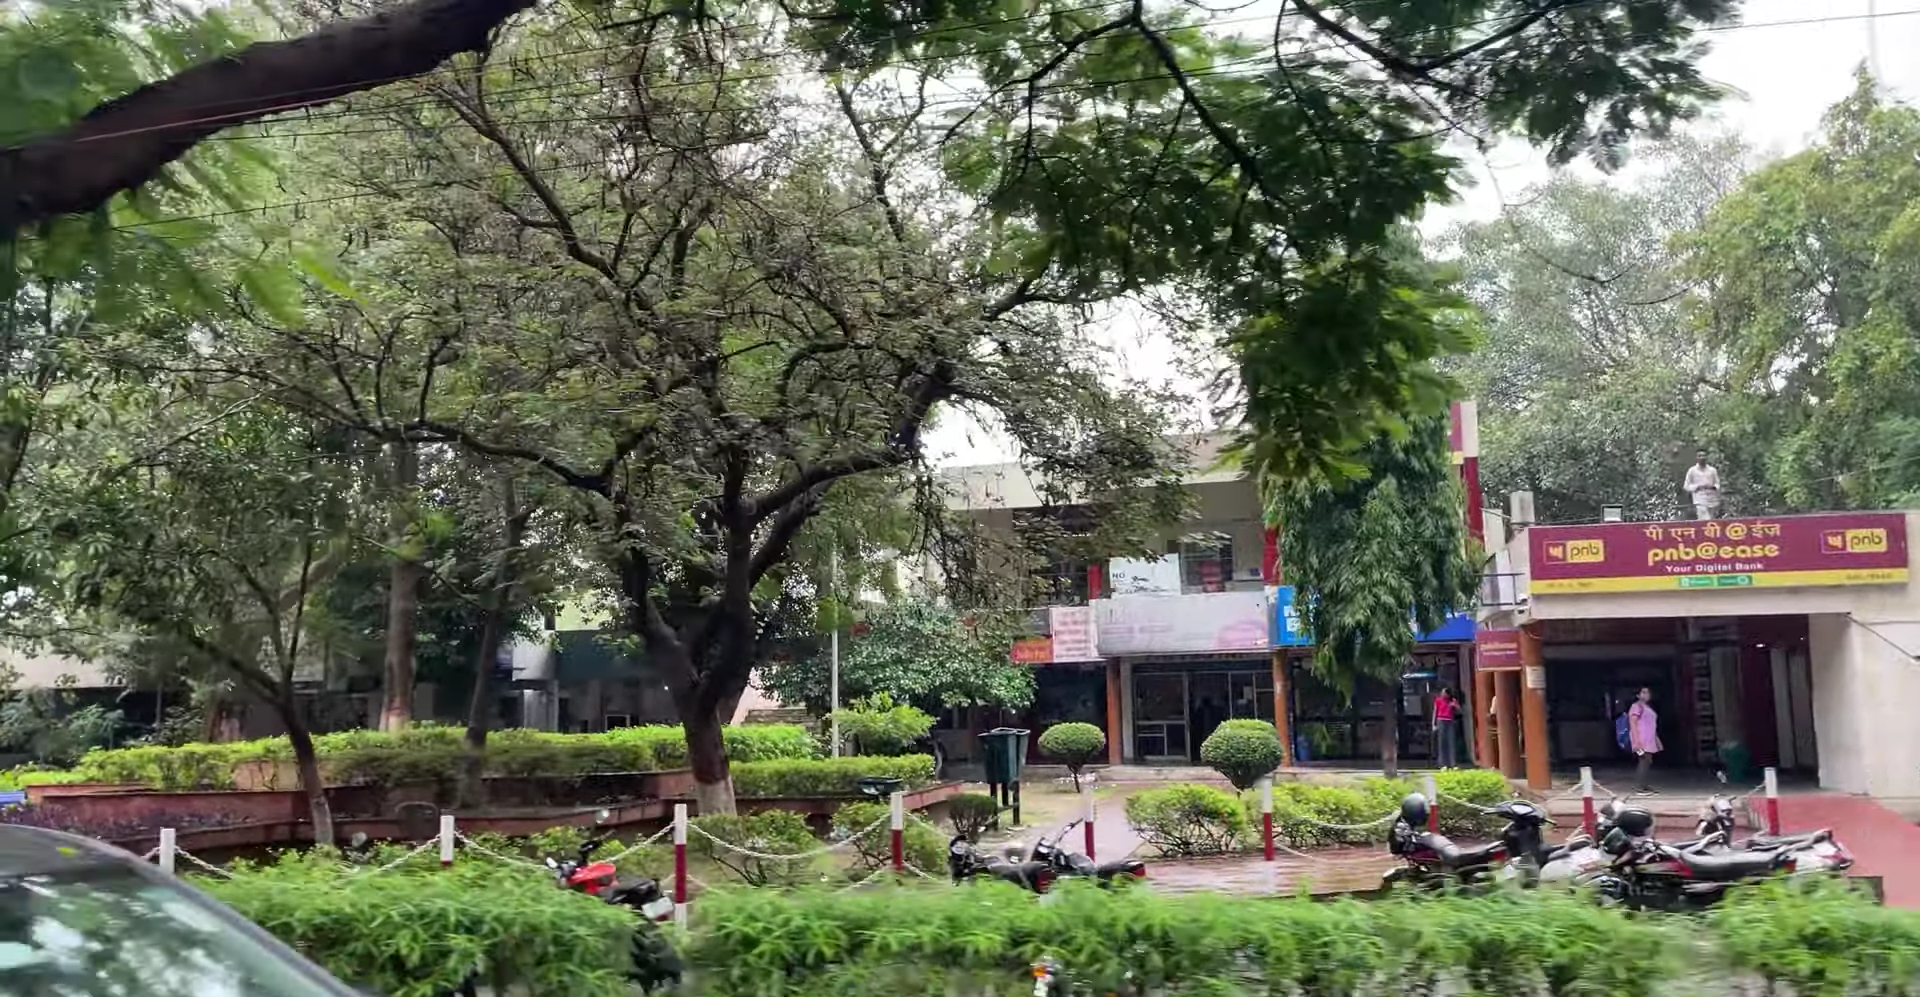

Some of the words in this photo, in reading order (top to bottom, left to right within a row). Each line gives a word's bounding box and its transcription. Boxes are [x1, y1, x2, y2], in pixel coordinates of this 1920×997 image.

[1644, 525, 1663, 541] पी
[1670, 527, 1695, 541] एन
[1850, 530, 1882, 551] pnb
[1570, 542, 1599, 561] pnb
[1647, 542, 1780, 566] pnb@ease
[1665, 565, 1691, 573] Your
[1695, 563, 1731, 573] Digital
[1735, 562, 1764, 571] Bank
